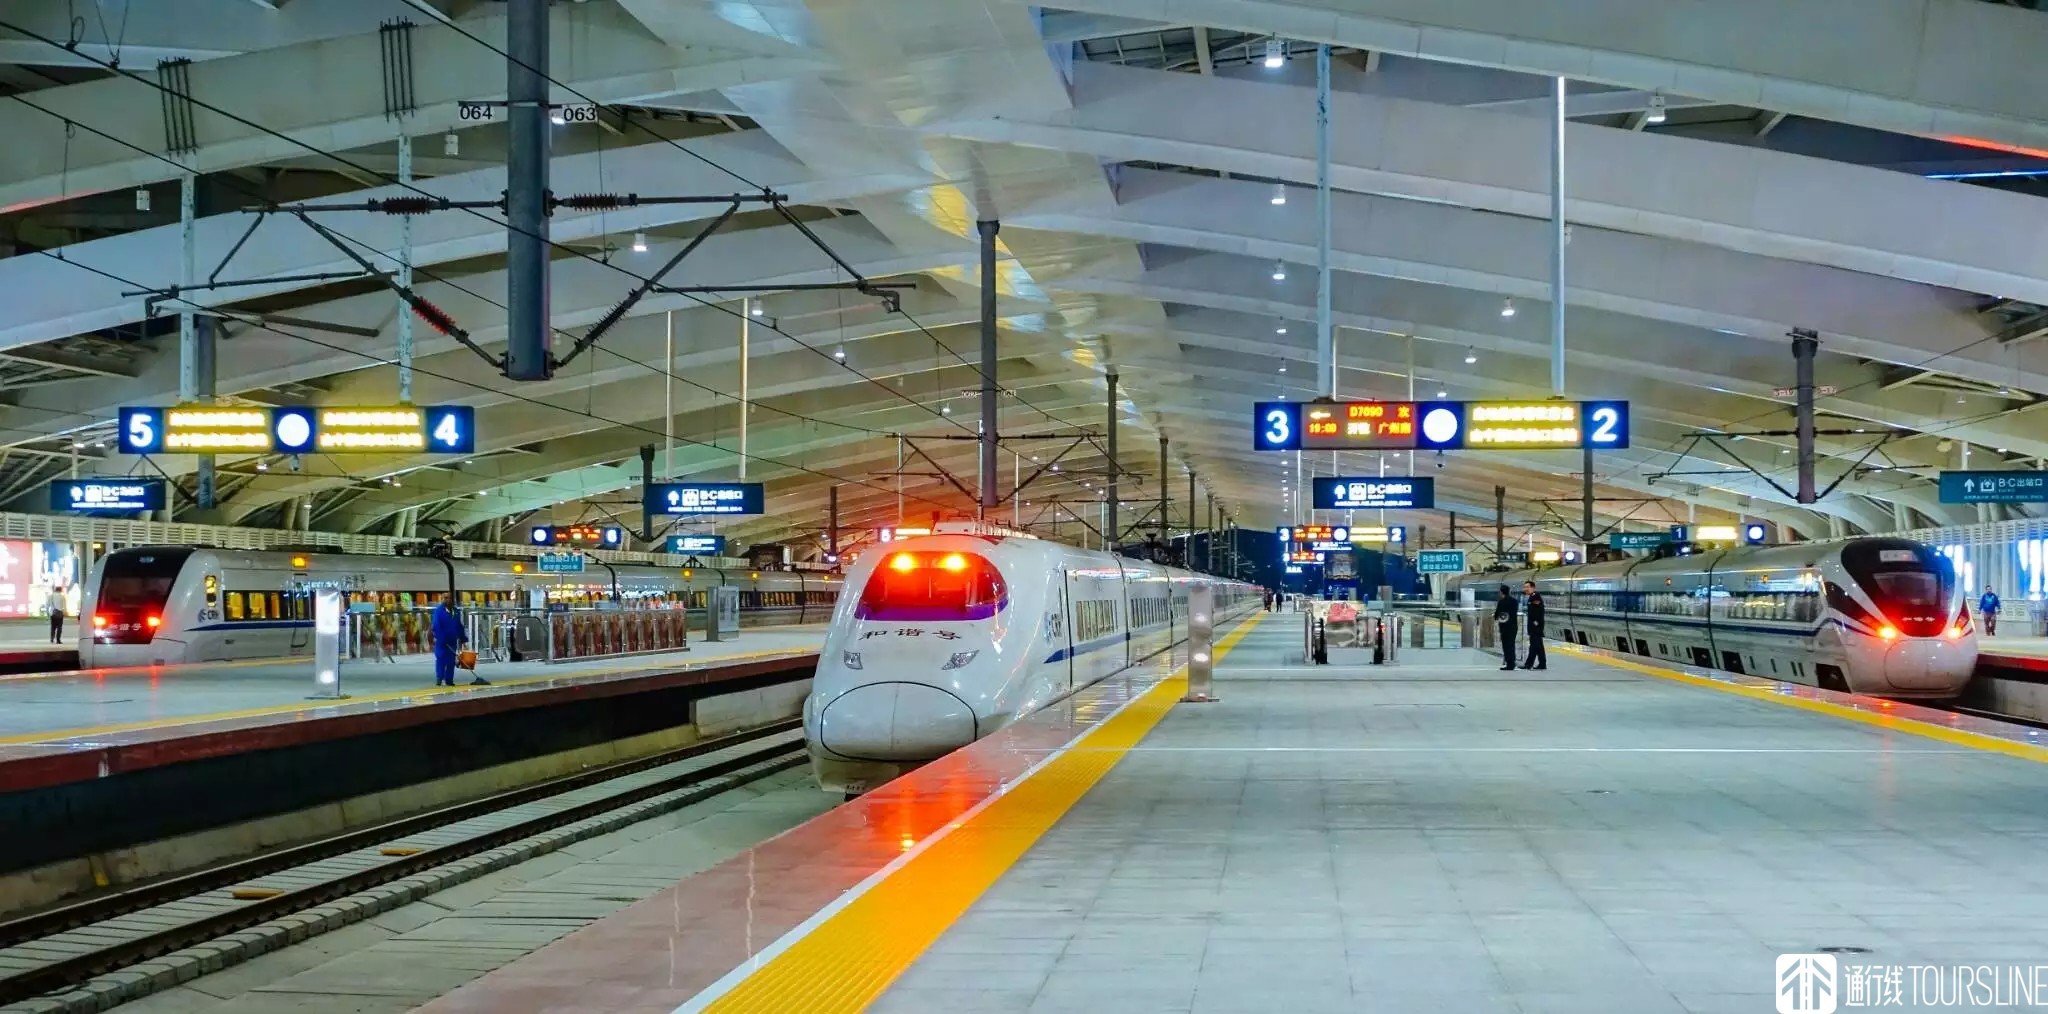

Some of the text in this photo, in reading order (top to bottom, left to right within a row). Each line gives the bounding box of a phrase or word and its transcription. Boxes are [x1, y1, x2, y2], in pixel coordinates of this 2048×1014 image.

[460, 105, 493, 120] 064
[563, 107, 596, 122] 063
[129, 413, 153, 447] 5
[433, 414, 459, 446] 4
[1266, 410, 1290, 443] 3
[1591, 409, 1618, 442] 2
[1279, 528, 1290, 541] 3
[1391, 528, 1402, 542] 2
[1675, 527, 1683, 539] 1
[859, 627, 963, 641] 和谐号
